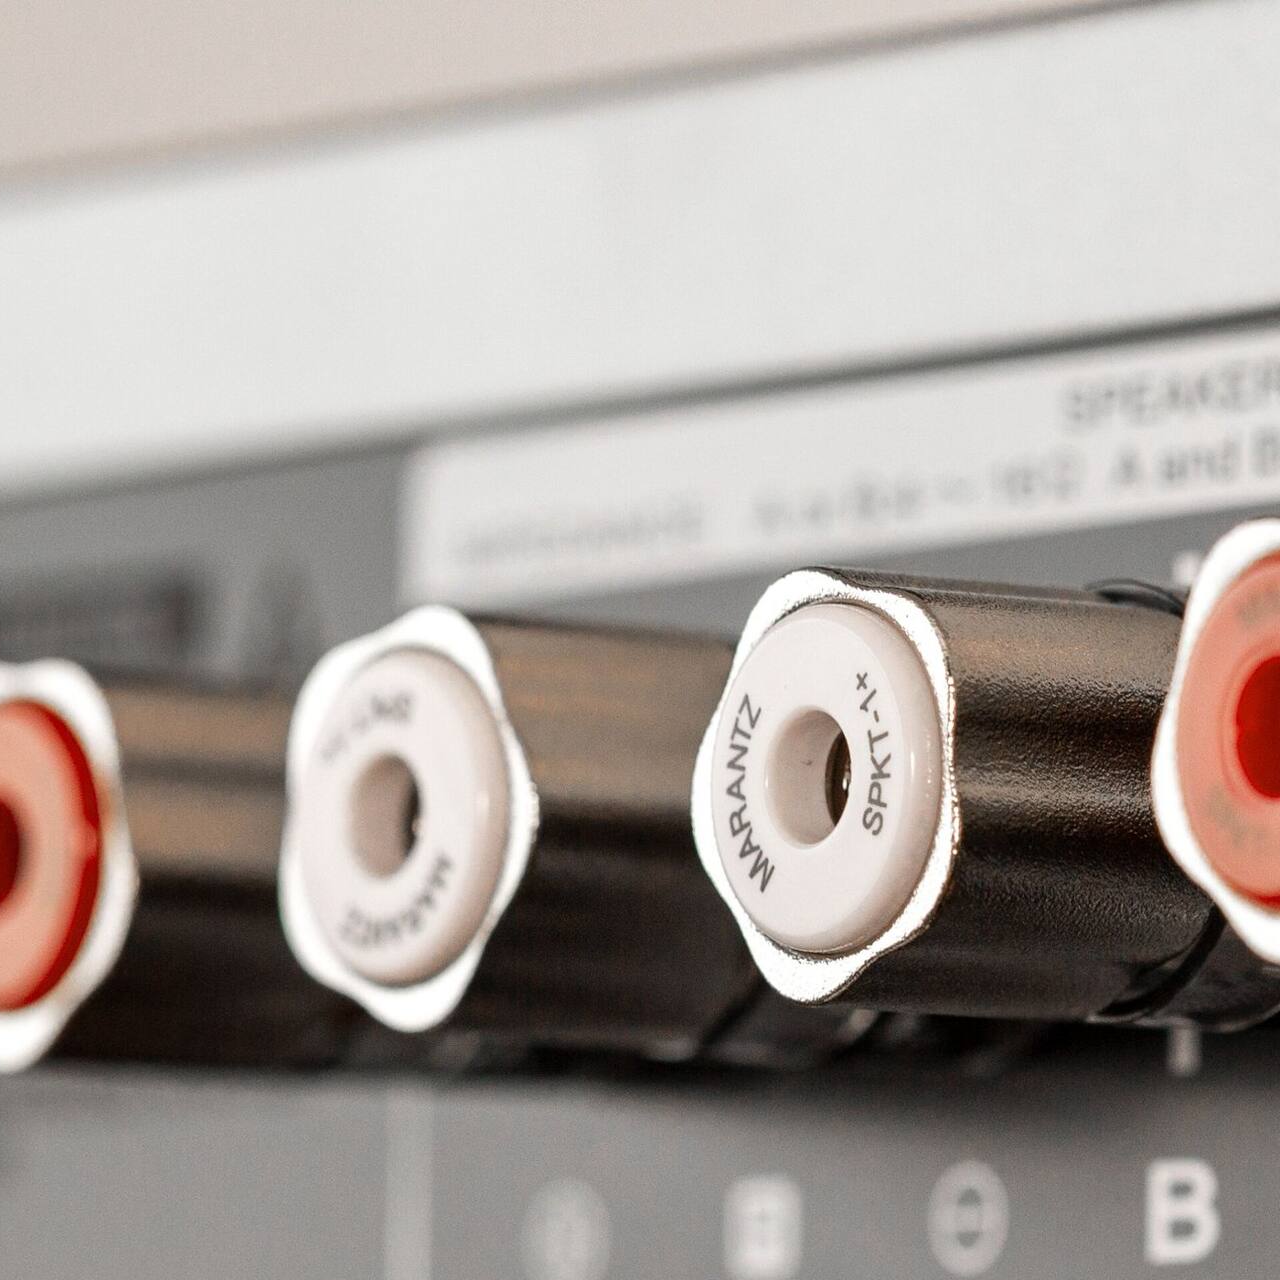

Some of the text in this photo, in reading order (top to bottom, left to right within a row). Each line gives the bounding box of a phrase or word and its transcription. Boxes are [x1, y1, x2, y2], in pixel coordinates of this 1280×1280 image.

[1154, 438, 1239, 486] and
[726, 693, 775, 893] MARANTZ
[1144, 1157, 1220, 1266] B
